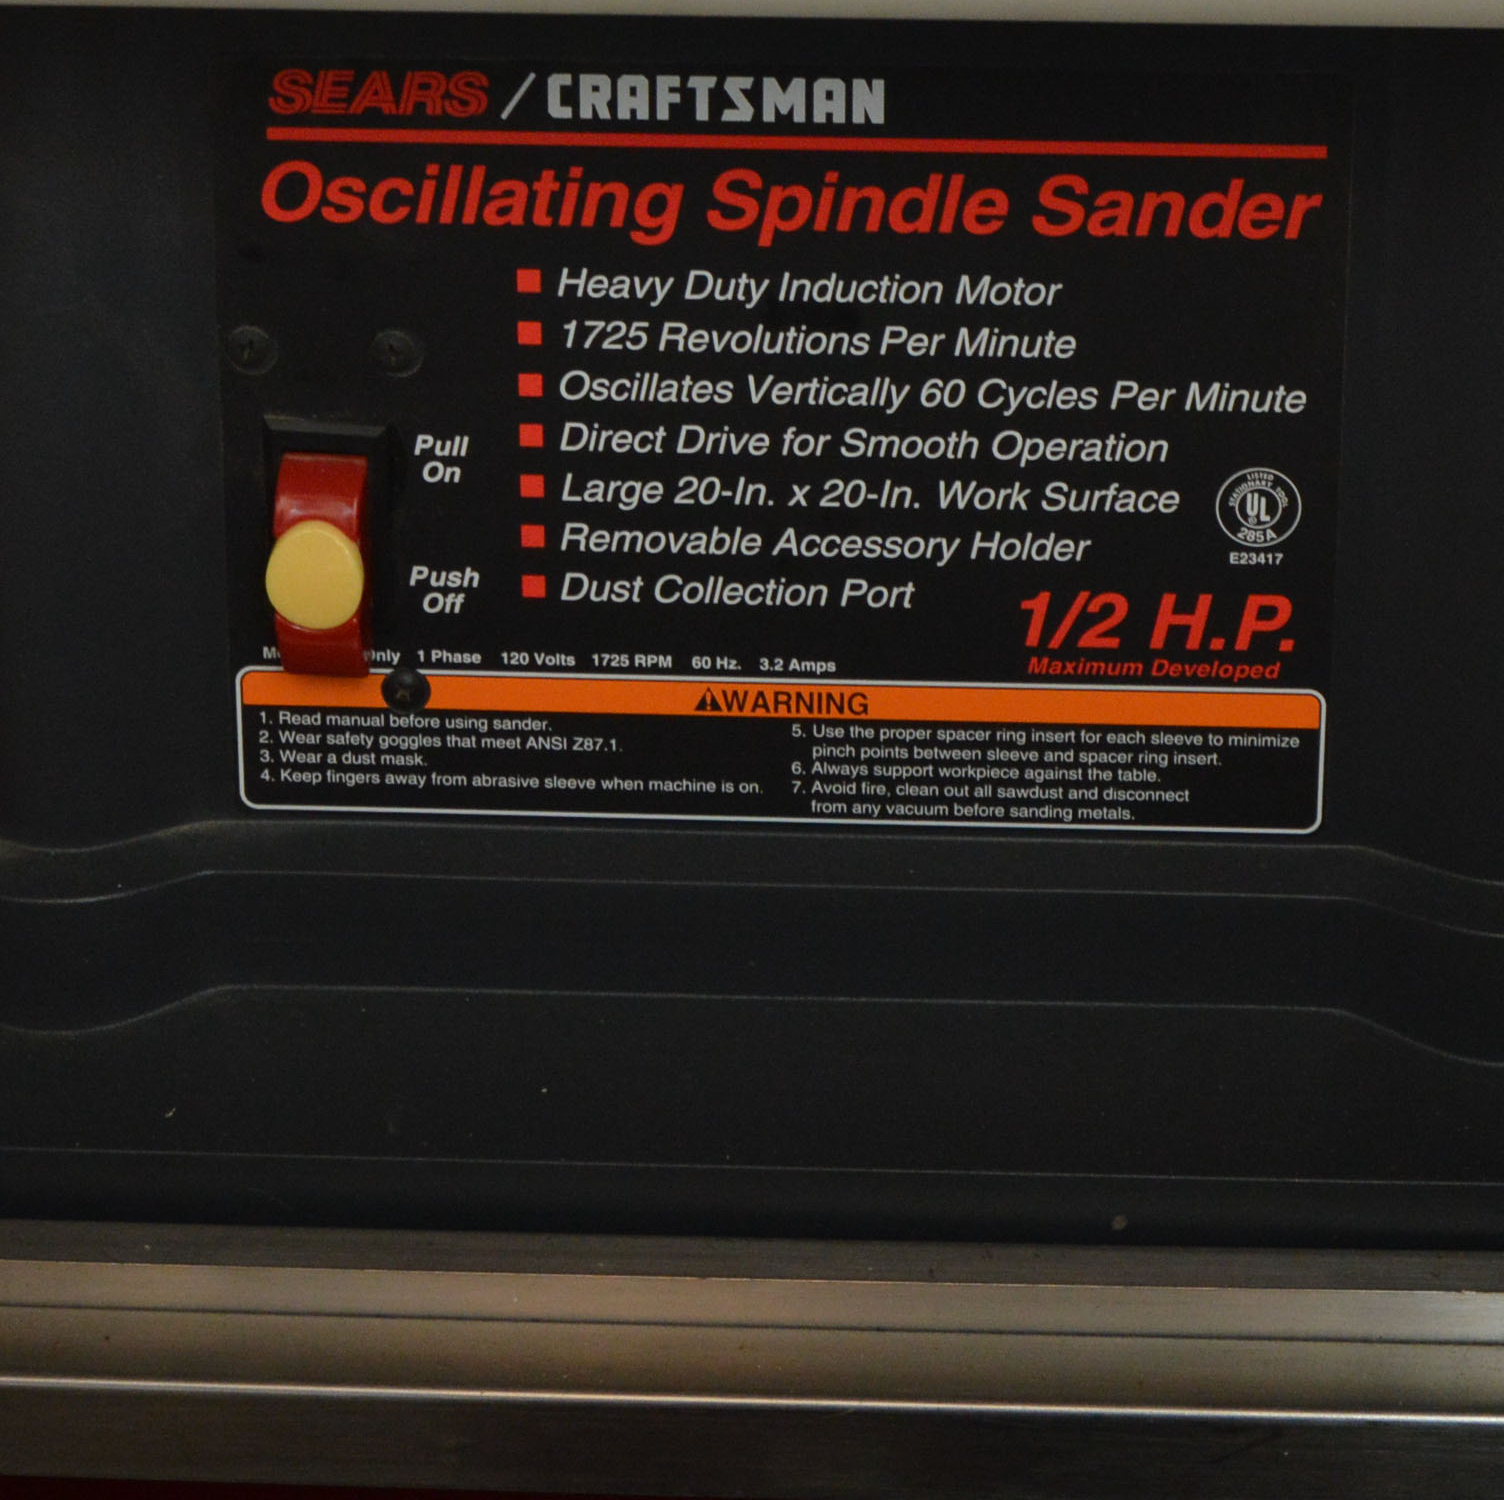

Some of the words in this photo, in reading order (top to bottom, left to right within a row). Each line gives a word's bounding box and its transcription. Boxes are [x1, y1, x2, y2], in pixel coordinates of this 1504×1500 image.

[268, 68, 489, 118] SEARS
[547, 73, 885, 124] CRAFTSMAN
[262, 160, 684, 246] Oscillating
[707, 168, 1010, 247] Spindle
[1032, 174, 1323, 240] Sander
[558, 267, 674, 307] Heavy
[684, 270, 770, 309] Duty
[778, 272, 943, 304] Induction
[955, 274, 1063, 306] Motor
[564, 320, 649, 350] 1725
[658, 322, 870, 356] Revolutions
[880, 326, 946, 356] Per
[954, 327, 1076, 359] Minute
[560, 370, 734, 404] Oscillates
[748, 374, 910, 414] Vertically
[920, 378, 966, 408] 60
[978, 378, 1098, 416] Cycles
[1110, 380, 1176, 411] Per
[1184, 382, 1306, 414] Minute
[414, 434, 469, 457] Pull
[560, 422, 666, 453] Direct
[676, 425, 770, 456] Drive
[782, 426, 831, 456] for
[840, 427, 979, 459] Smooth
[992, 430, 1168, 468] Operation
[422, 461, 461, 483] On
[562, 473, 664, 511] Large
[674, 476, 774, 506] 20-In.
[788, 484, 810, 506] x
[819, 479, 920, 508] 20-In.
[939, 480, 1031, 510] Work
[1041, 482, 1180, 513] Surface
[561, 522, 762, 556] Removable
[772, 527, 960, 567] Accessory
[970, 531, 1092, 562] Holder
[1229, 552, 1284, 565] E23417
[410, 566, 480, 588] Push
[561, 572, 644, 602] Dust
[654, 574, 828, 606] Collection
[840, 578, 915, 608] Port
[422, 592, 465, 614] Off
[1021, 591, 1129, 649] 1/2
[1150, 593, 1295, 652] H.P.
[431, 650, 482, 664] Phase
[501, 652, 529, 665] 120
[534, 652, 576, 666] Volts
[592, 654, 630, 667] 1725
[634, 654, 672, 668] RPM
[692, 656, 711, 669] 60
[716, 656, 741, 670] Hz.
[760, 658, 784, 671] 3.2
[788, 658, 836, 675] Amps
[1028, 656, 1144, 676] Maximum
[1151, 658, 1281, 682] Developed
[721, 690, 870, 716] WARNING
[279, 710, 321, 726] Read
[326, 714, 384, 727] manual
[389, 714, 440, 728] before
[445, 718, 488, 733] using
[493, 718, 552, 731] sander.
[278, 730, 322, 744] Wear
[326, 731, 374, 749] safety
[378, 733, 442, 750] goggles
[481, 736, 521, 749] meet
[526, 736, 567, 750] ANSI
[813, 724, 845, 738] Use
[880, 728, 932, 742] proper
[937, 729, 991, 744] spacer
[996, 729, 1026, 745] ring
[1031, 729, 1075, 743] insert
[1151, 731, 1203, 746] sleeve
[1228, 734, 1300, 748] minimize
[279, 749, 322, 764] Wear
[342, 751, 376, 765] dust
[380, 753, 427, 766] mask.
[812, 744, 855, 760] pinch
[860, 746, 908, 761] points
[914, 746, 982, 760] between
[987, 748, 1039, 762] sleeve
[1044, 749, 1074, 762] and
[1079, 752, 1134, 766] spacer
[1138, 750, 1168, 768] ring
[1174, 751, 1221, 765] insert.
[280, 768, 322, 785] Keep
[326, 769, 380, 787] fingers
[385, 774, 426, 788] away
[431, 772, 467, 786] from
[472, 774, 540, 788] abrasive
[544, 775, 596, 790] sleeve
[600, 776, 644, 791] when
[648, 778, 716, 792] machine
[811, 761, 868, 779] Always
[873, 764, 933, 780] support
[938, 764, 1020, 781] workpiece
[1024, 767, 1082, 783] against
[1118, 768, 1160, 782] table.
[811, 780, 856, 794] Avoid
[861, 781, 890, 797] fire,
[896, 782, 939, 796] clean
[997, 785, 1063, 799] sawdust
[1103, 787, 1189, 802] disconnect
[811, 800, 847, 813] from
[886, 804, 948, 816] vacuum
[954, 803, 1005, 817] before
[1010, 805, 1073, 822] sanding
[1078, 806, 1135, 820] metals.
